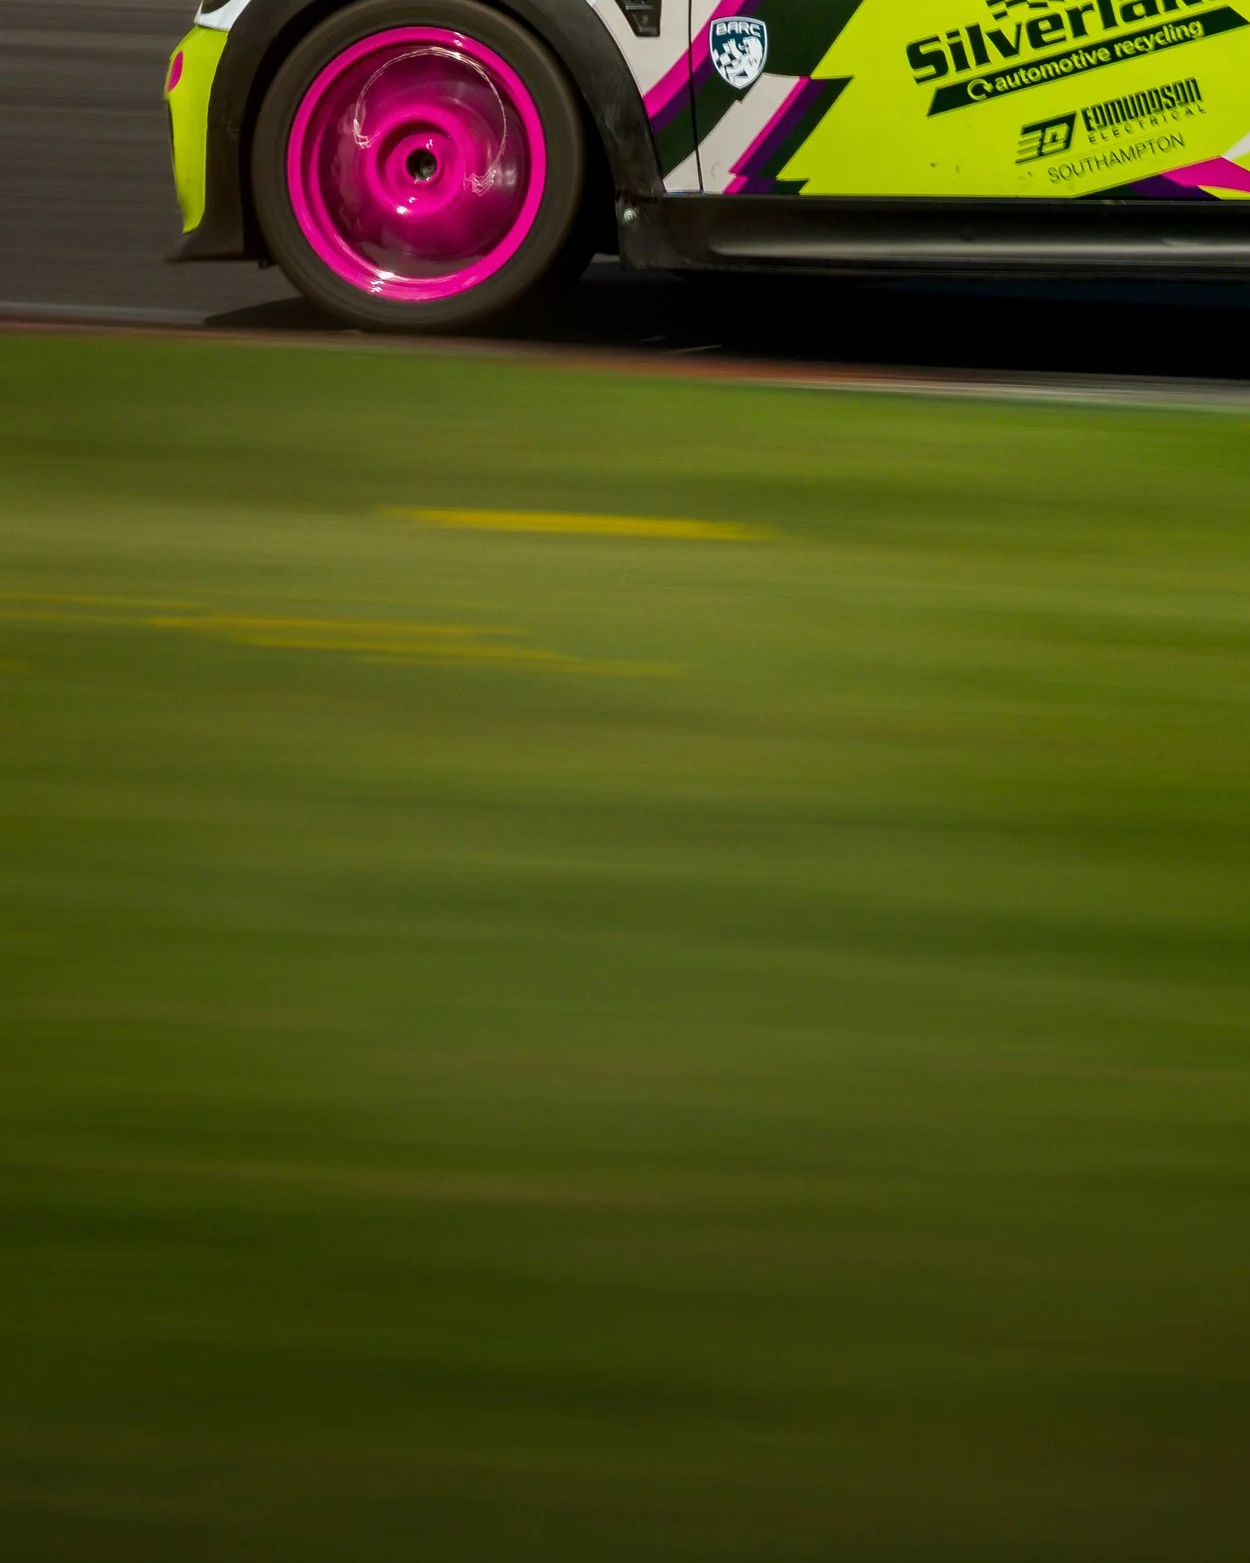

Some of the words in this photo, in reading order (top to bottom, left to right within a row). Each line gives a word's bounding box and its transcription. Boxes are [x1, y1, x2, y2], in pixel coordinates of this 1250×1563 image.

[716, 21, 762, 38] BARC
[994, 45, 1112, 93] automotive
[1114, 18, 1205, 57] recycling
[1088, 105, 1207, 145] ELECTRICAL
[1047, 132, 1187, 184] SOUTHAMPTON
